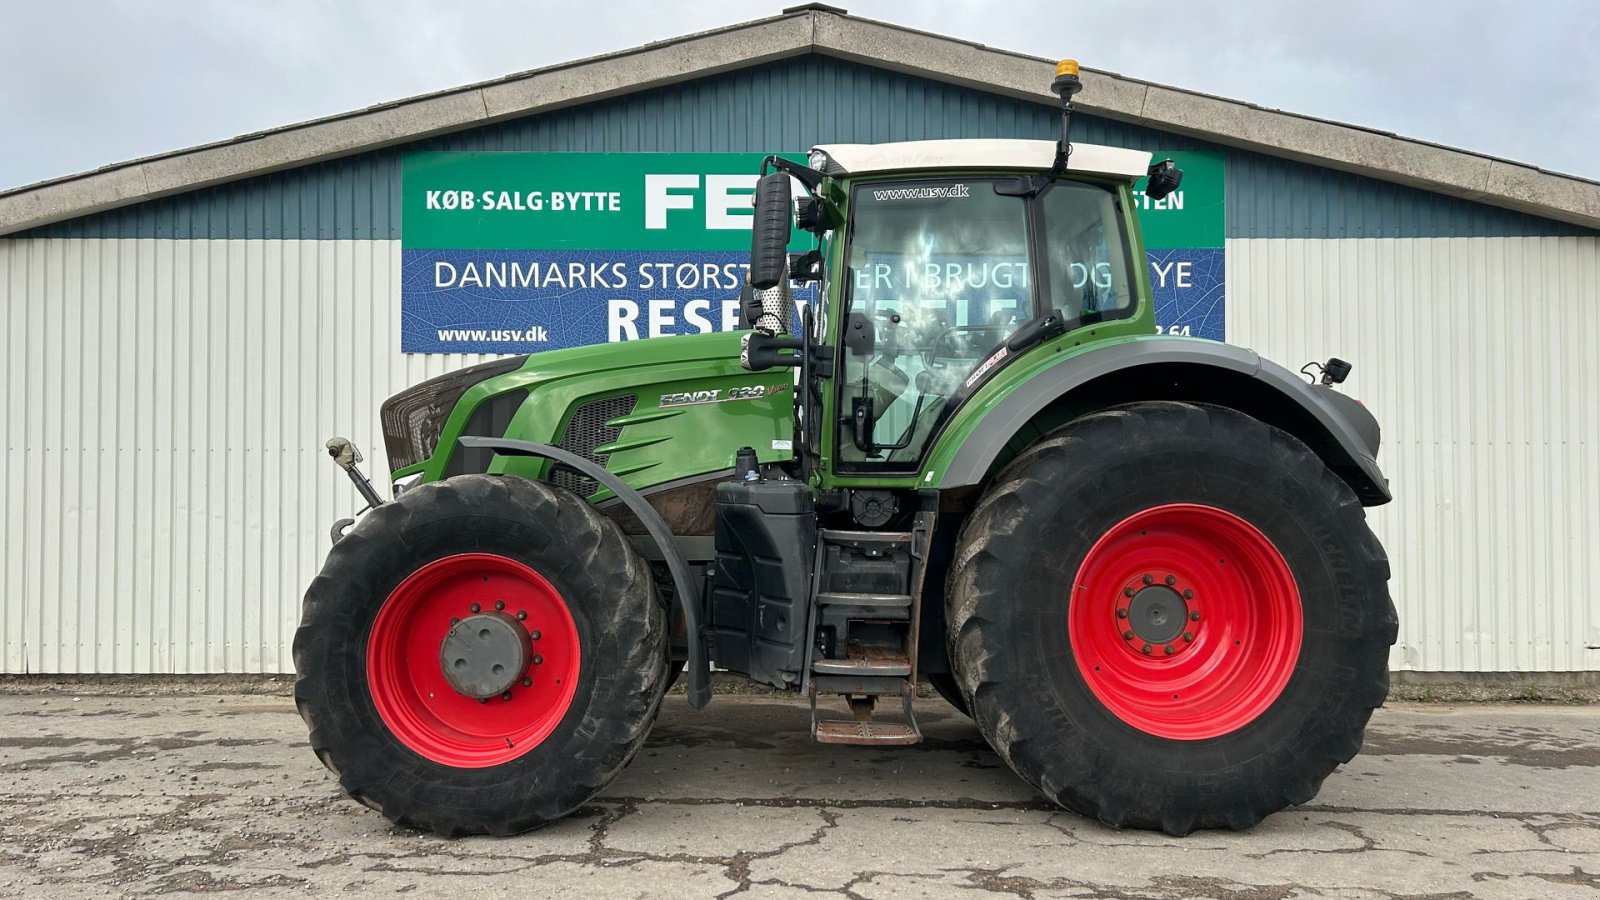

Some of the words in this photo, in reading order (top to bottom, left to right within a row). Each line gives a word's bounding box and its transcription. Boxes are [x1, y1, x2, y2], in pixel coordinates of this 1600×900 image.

[873, 184, 970, 201] www.usv.dk
[645, 174, 755, 230] FE
[435, 261, 628, 289] DANMARKS
[1151, 261, 1192, 288] YE
[437, 326, 548, 342] www.usv.dk
[660, 389, 723, 406] FENDT
